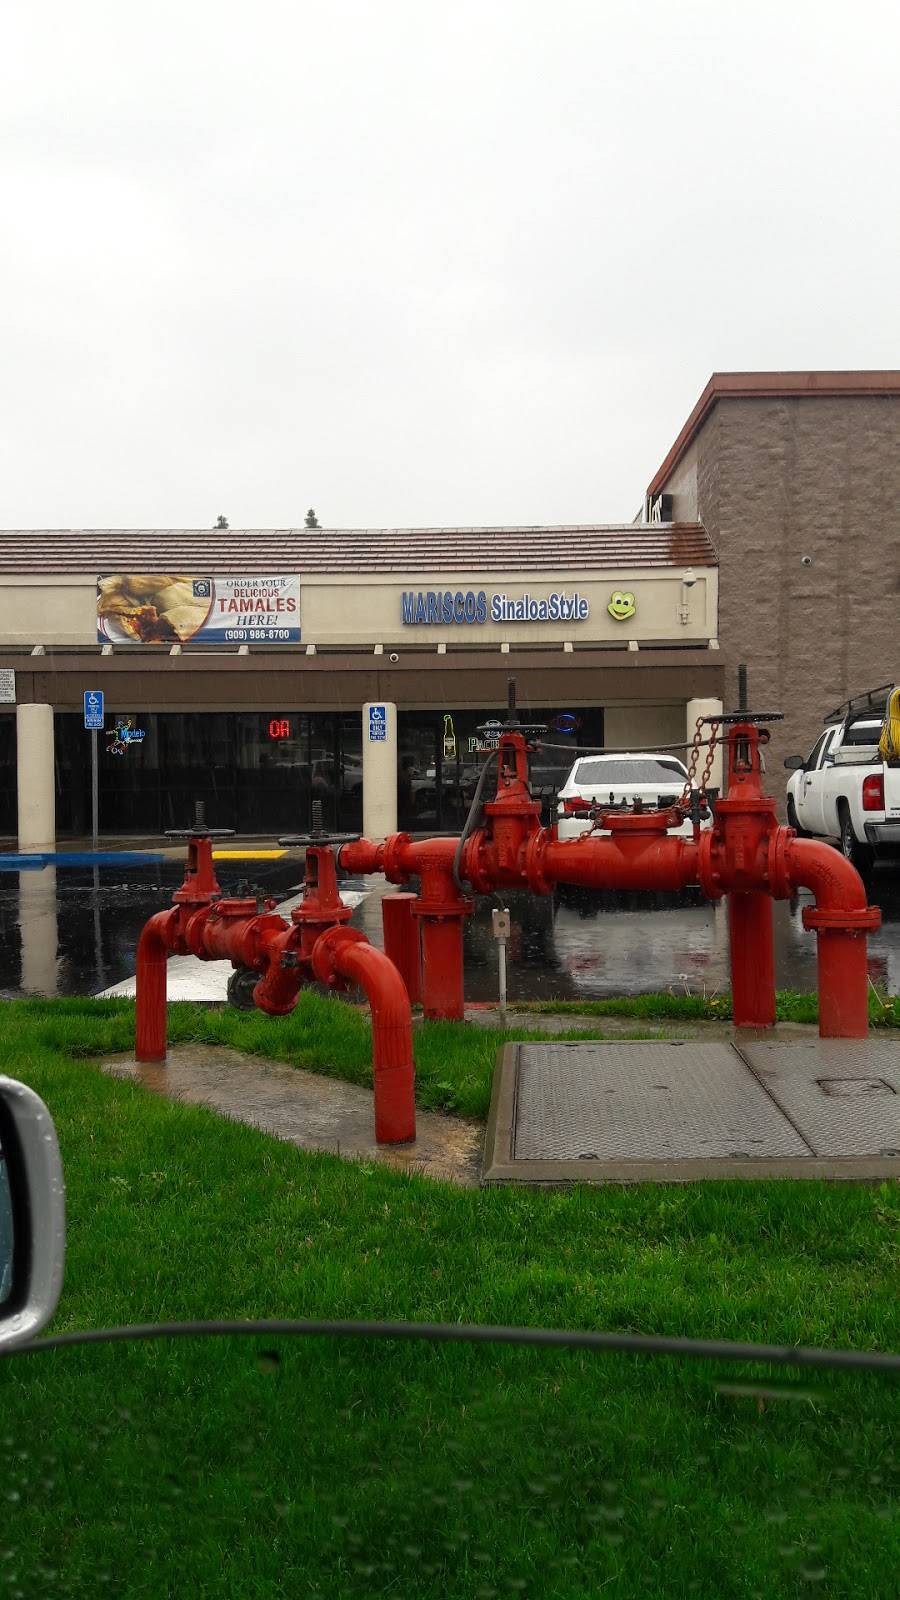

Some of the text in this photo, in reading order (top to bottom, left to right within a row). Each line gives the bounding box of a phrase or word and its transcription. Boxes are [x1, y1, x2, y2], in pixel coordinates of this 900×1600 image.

[226, 579, 286, 588] ORDER YOUR
[233, 588, 280, 598] DELICIOUS
[218, 598, 297, 613] TAMALES
[402, 591, 488, 625] MARISCOS
[236, 614, 279, 626] HERE!
[225, 629, 290, 640] (909) 986-8700
